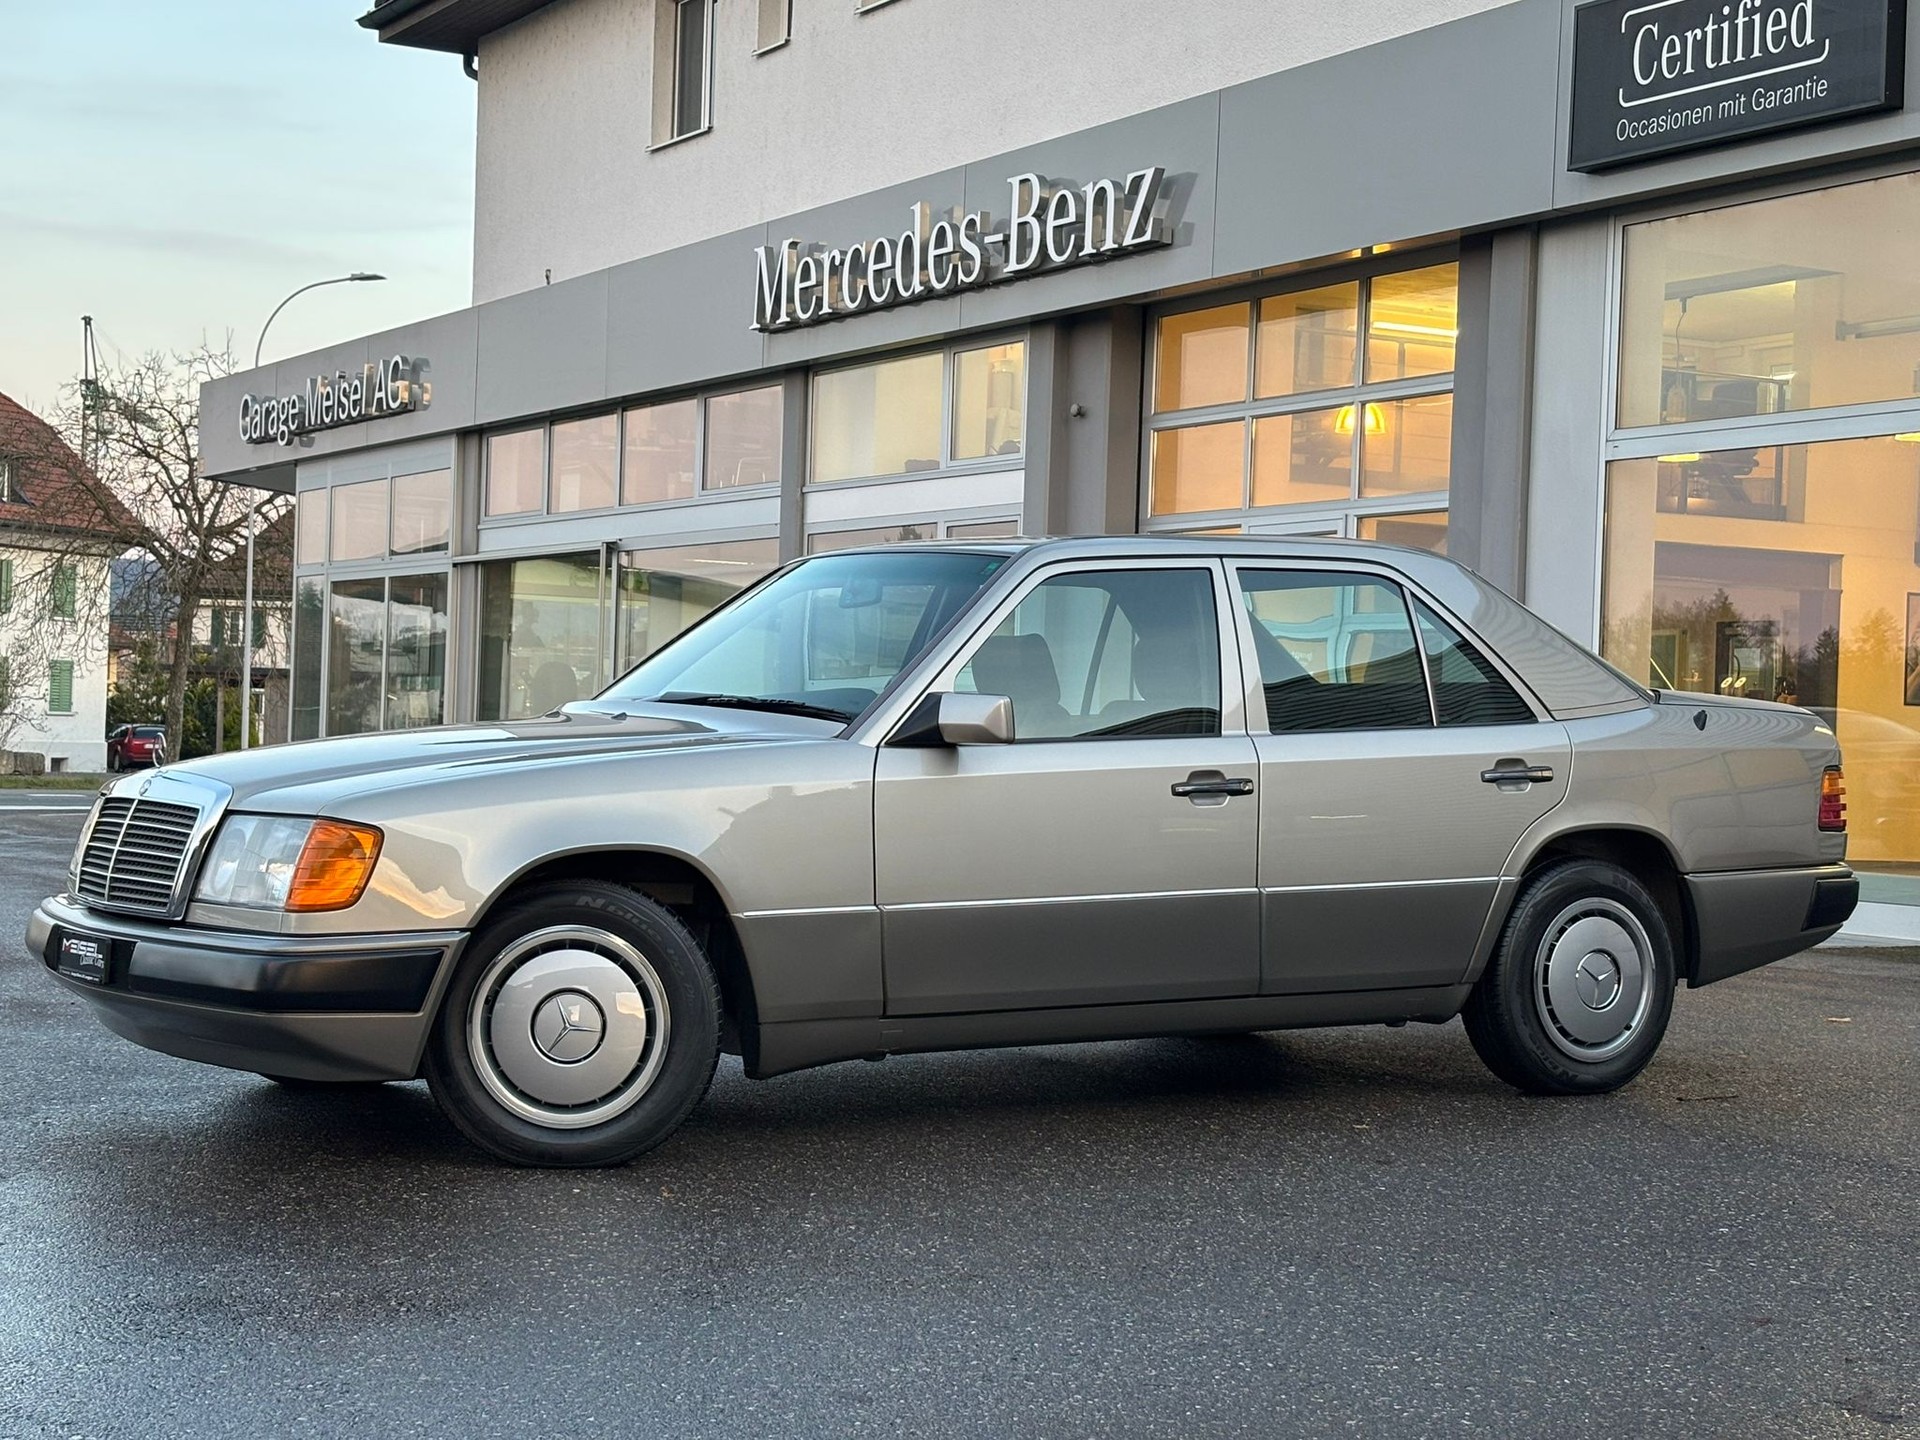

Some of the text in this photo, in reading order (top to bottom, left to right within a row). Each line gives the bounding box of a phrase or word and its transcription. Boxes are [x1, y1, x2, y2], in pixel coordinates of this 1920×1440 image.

[1632, 0, 1815, 85] Certified
[1616, 75, 1828, 141] Occasionen mit Garantie
[749, 166, 1168, 331] Mercedes-Benz
[239, 355, 406, 446] Garage Meisel AG
